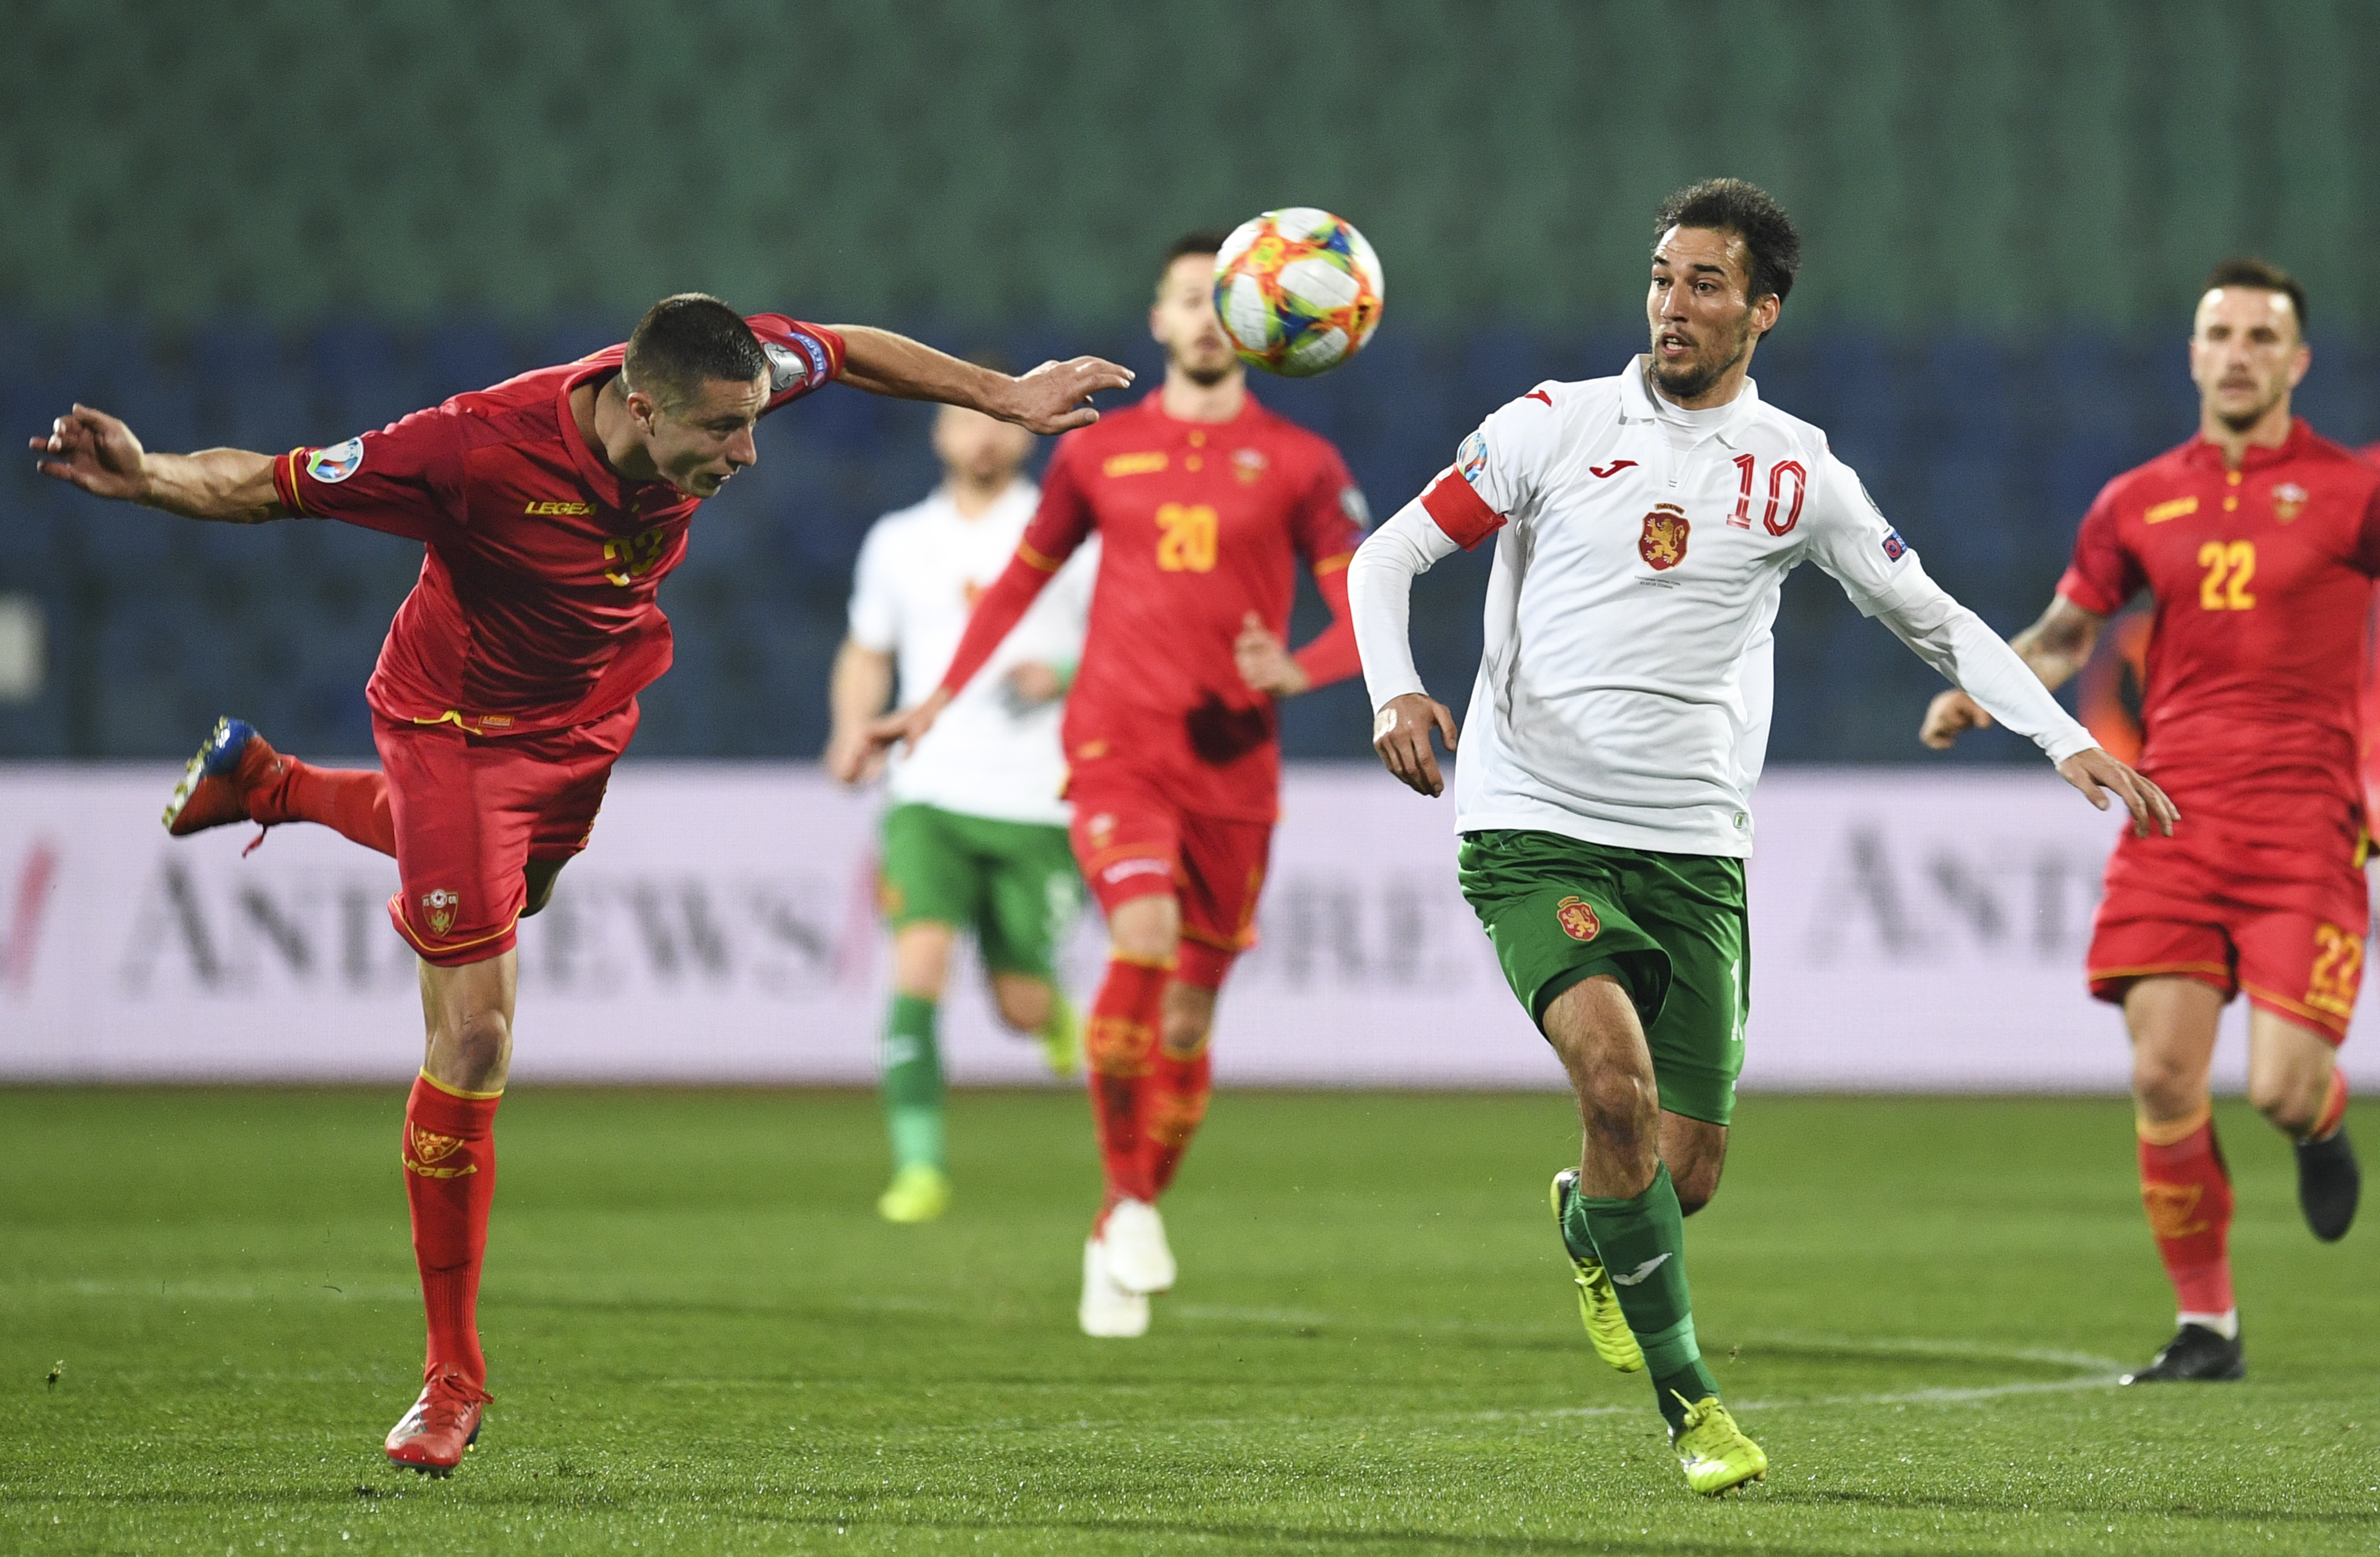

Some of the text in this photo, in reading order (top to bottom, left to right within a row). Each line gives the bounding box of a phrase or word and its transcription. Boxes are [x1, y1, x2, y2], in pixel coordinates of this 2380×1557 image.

[524, 501, 597, 516] LEGEA
[1726, 453, 1806, 537] 10
[1154, 501, 1219, 573] 20
[2198, 539, 2257, 611] 22
[120, 851, 834, 996] ANDEWS
[2310, 922, 2364, 998] 22
[1730, 959, 1743, 1041] 1
